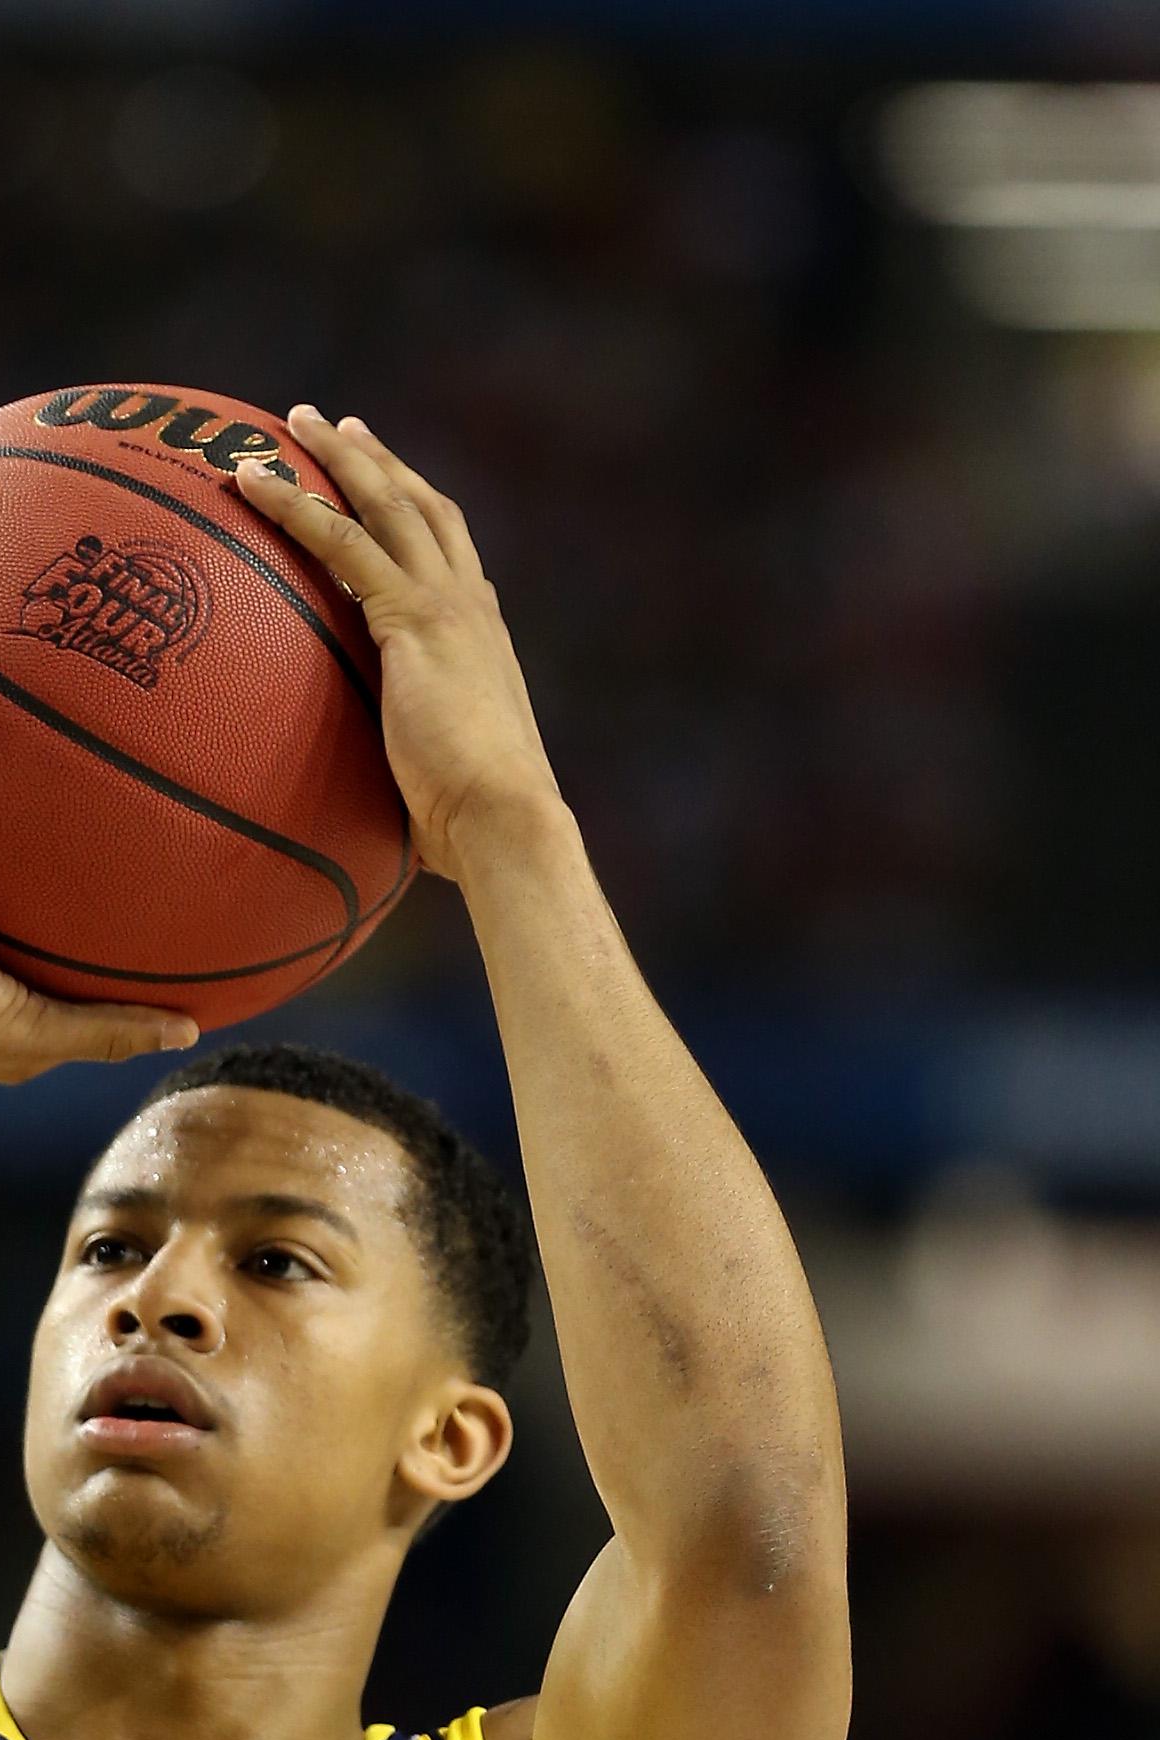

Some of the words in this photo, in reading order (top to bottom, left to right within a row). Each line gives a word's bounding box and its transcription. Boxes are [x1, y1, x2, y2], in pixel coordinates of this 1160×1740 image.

[118, 440, 214, 483] SOLUTION
[24, 553, 168, 661] FOUR
[89, 551, 186, 629] FINAL
[38, 617, 158, 688] Atlanta
